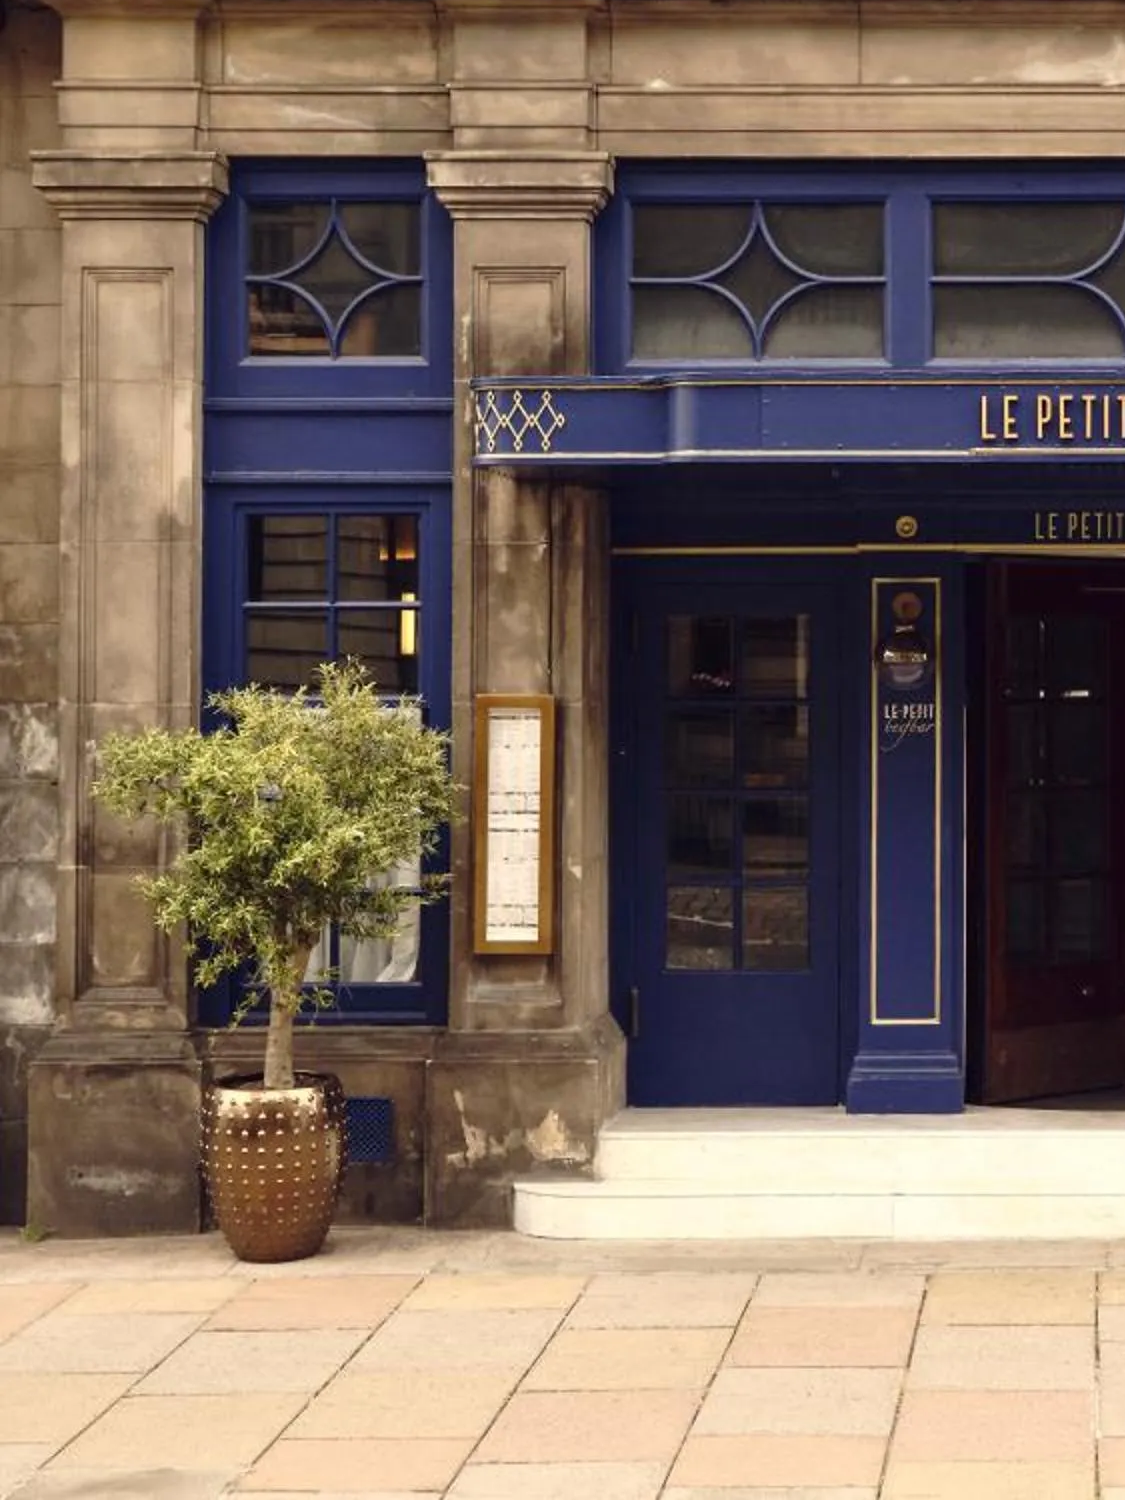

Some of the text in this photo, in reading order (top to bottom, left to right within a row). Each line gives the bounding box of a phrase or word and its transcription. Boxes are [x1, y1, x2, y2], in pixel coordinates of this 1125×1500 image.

[980, 395, 1018, 439] LE
[1035, 512, 1059, 539] LE
[1068, 512, 1125, 539] PETIT
[884, 704, 935, 719] LE PETIT
